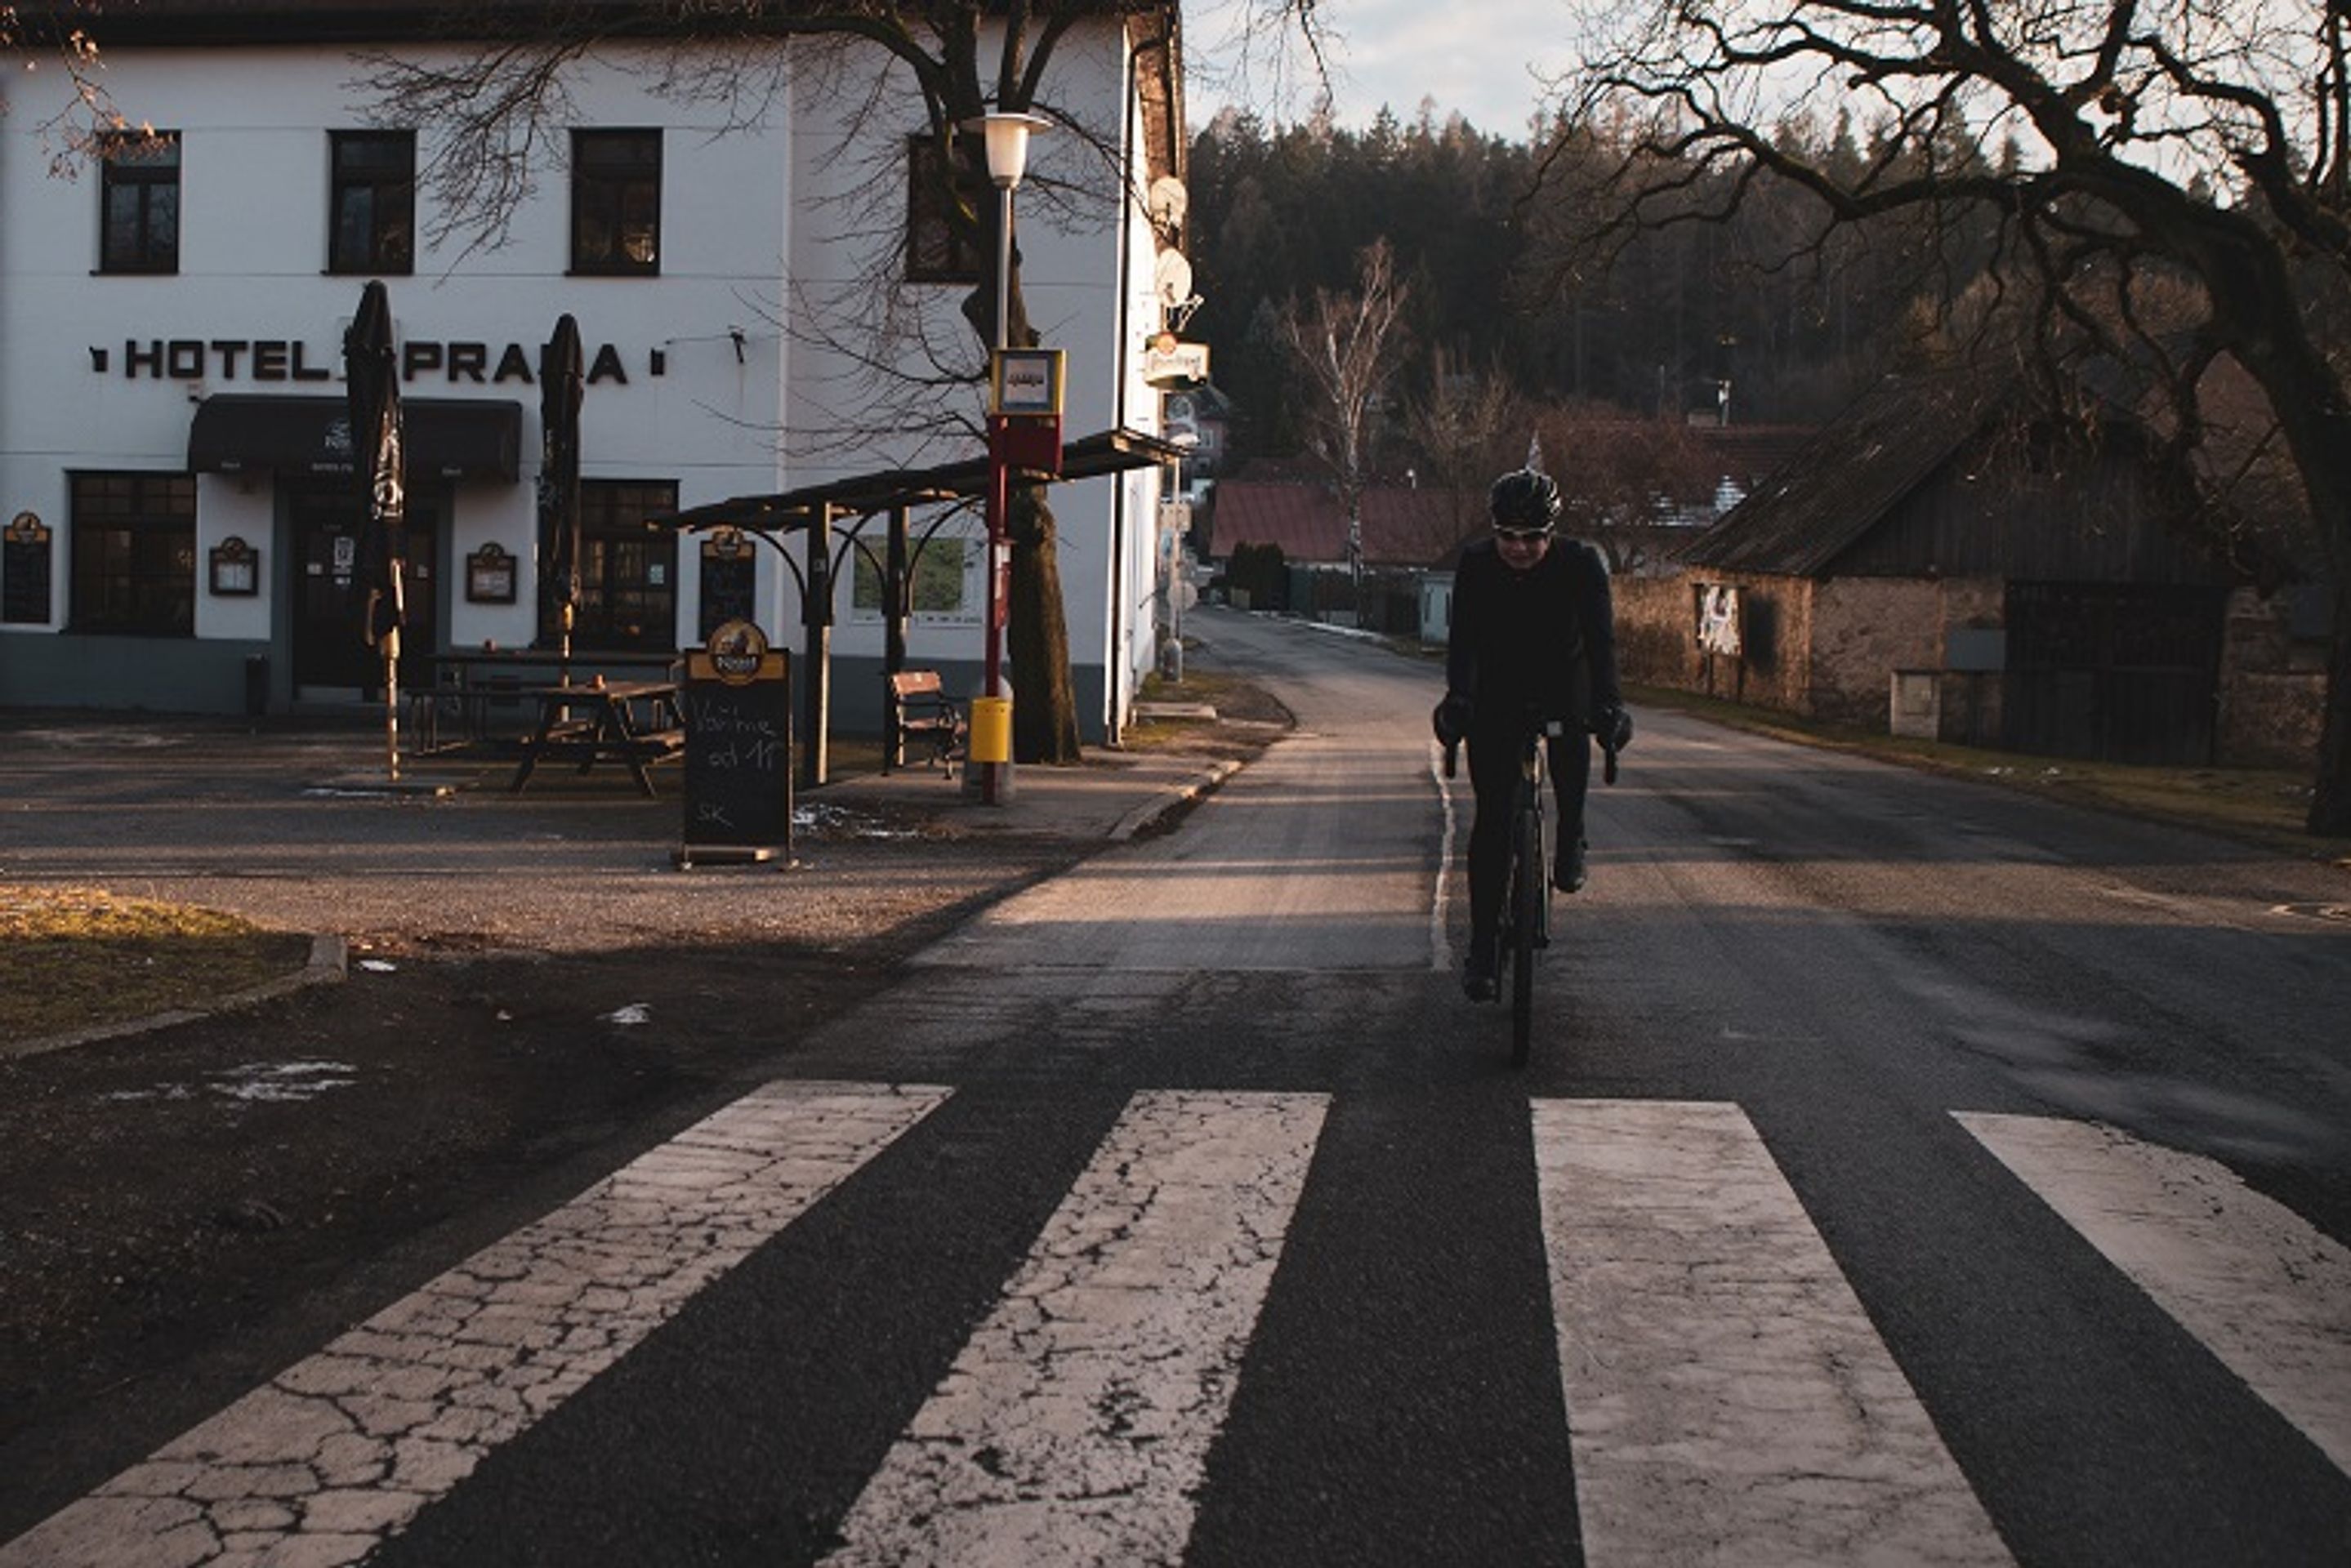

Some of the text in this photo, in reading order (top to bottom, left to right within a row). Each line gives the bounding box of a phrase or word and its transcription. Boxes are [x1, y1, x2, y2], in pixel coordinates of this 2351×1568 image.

[126, 340, 629, 385] HOTEL PRAA
[709, 744, 738, 768] od
